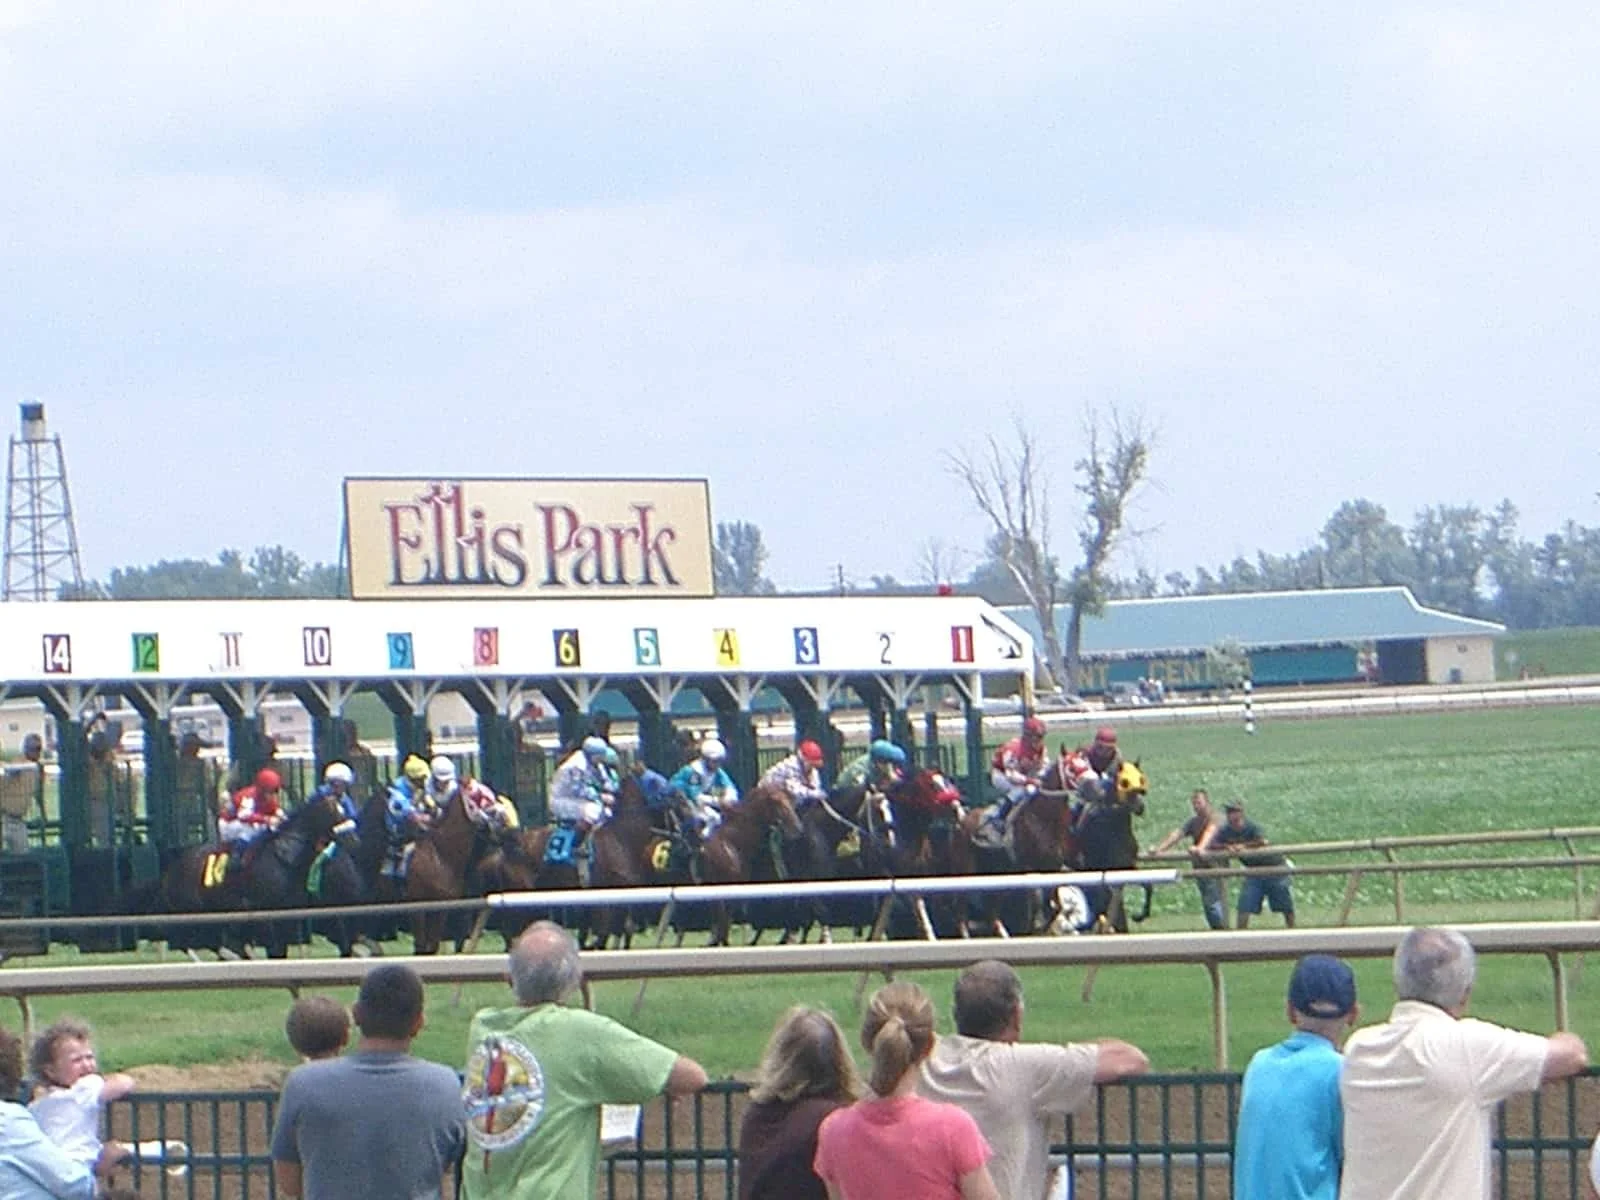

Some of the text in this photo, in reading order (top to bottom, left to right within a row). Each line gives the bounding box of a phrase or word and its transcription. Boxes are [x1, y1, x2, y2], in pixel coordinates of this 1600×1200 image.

[384, 483, 679, 588] Ellis Park
[44, 636, 70, 671] 14
[134, 635, 157, 668] 12
[223, 633, 240, 667] 11
[304, 628, 330, 665] 10
[393, 634, 409, 665] 9
[478, 629, 492, 662] 8
[558, 631, 576, 664] 6
[638, 630, 657, 664] 5
[719, 629, 734, 661] 4
[798, 629, 814, 663] 3
[878, 633, 893, 664] 2
[958, 628, 970, 661] 1
